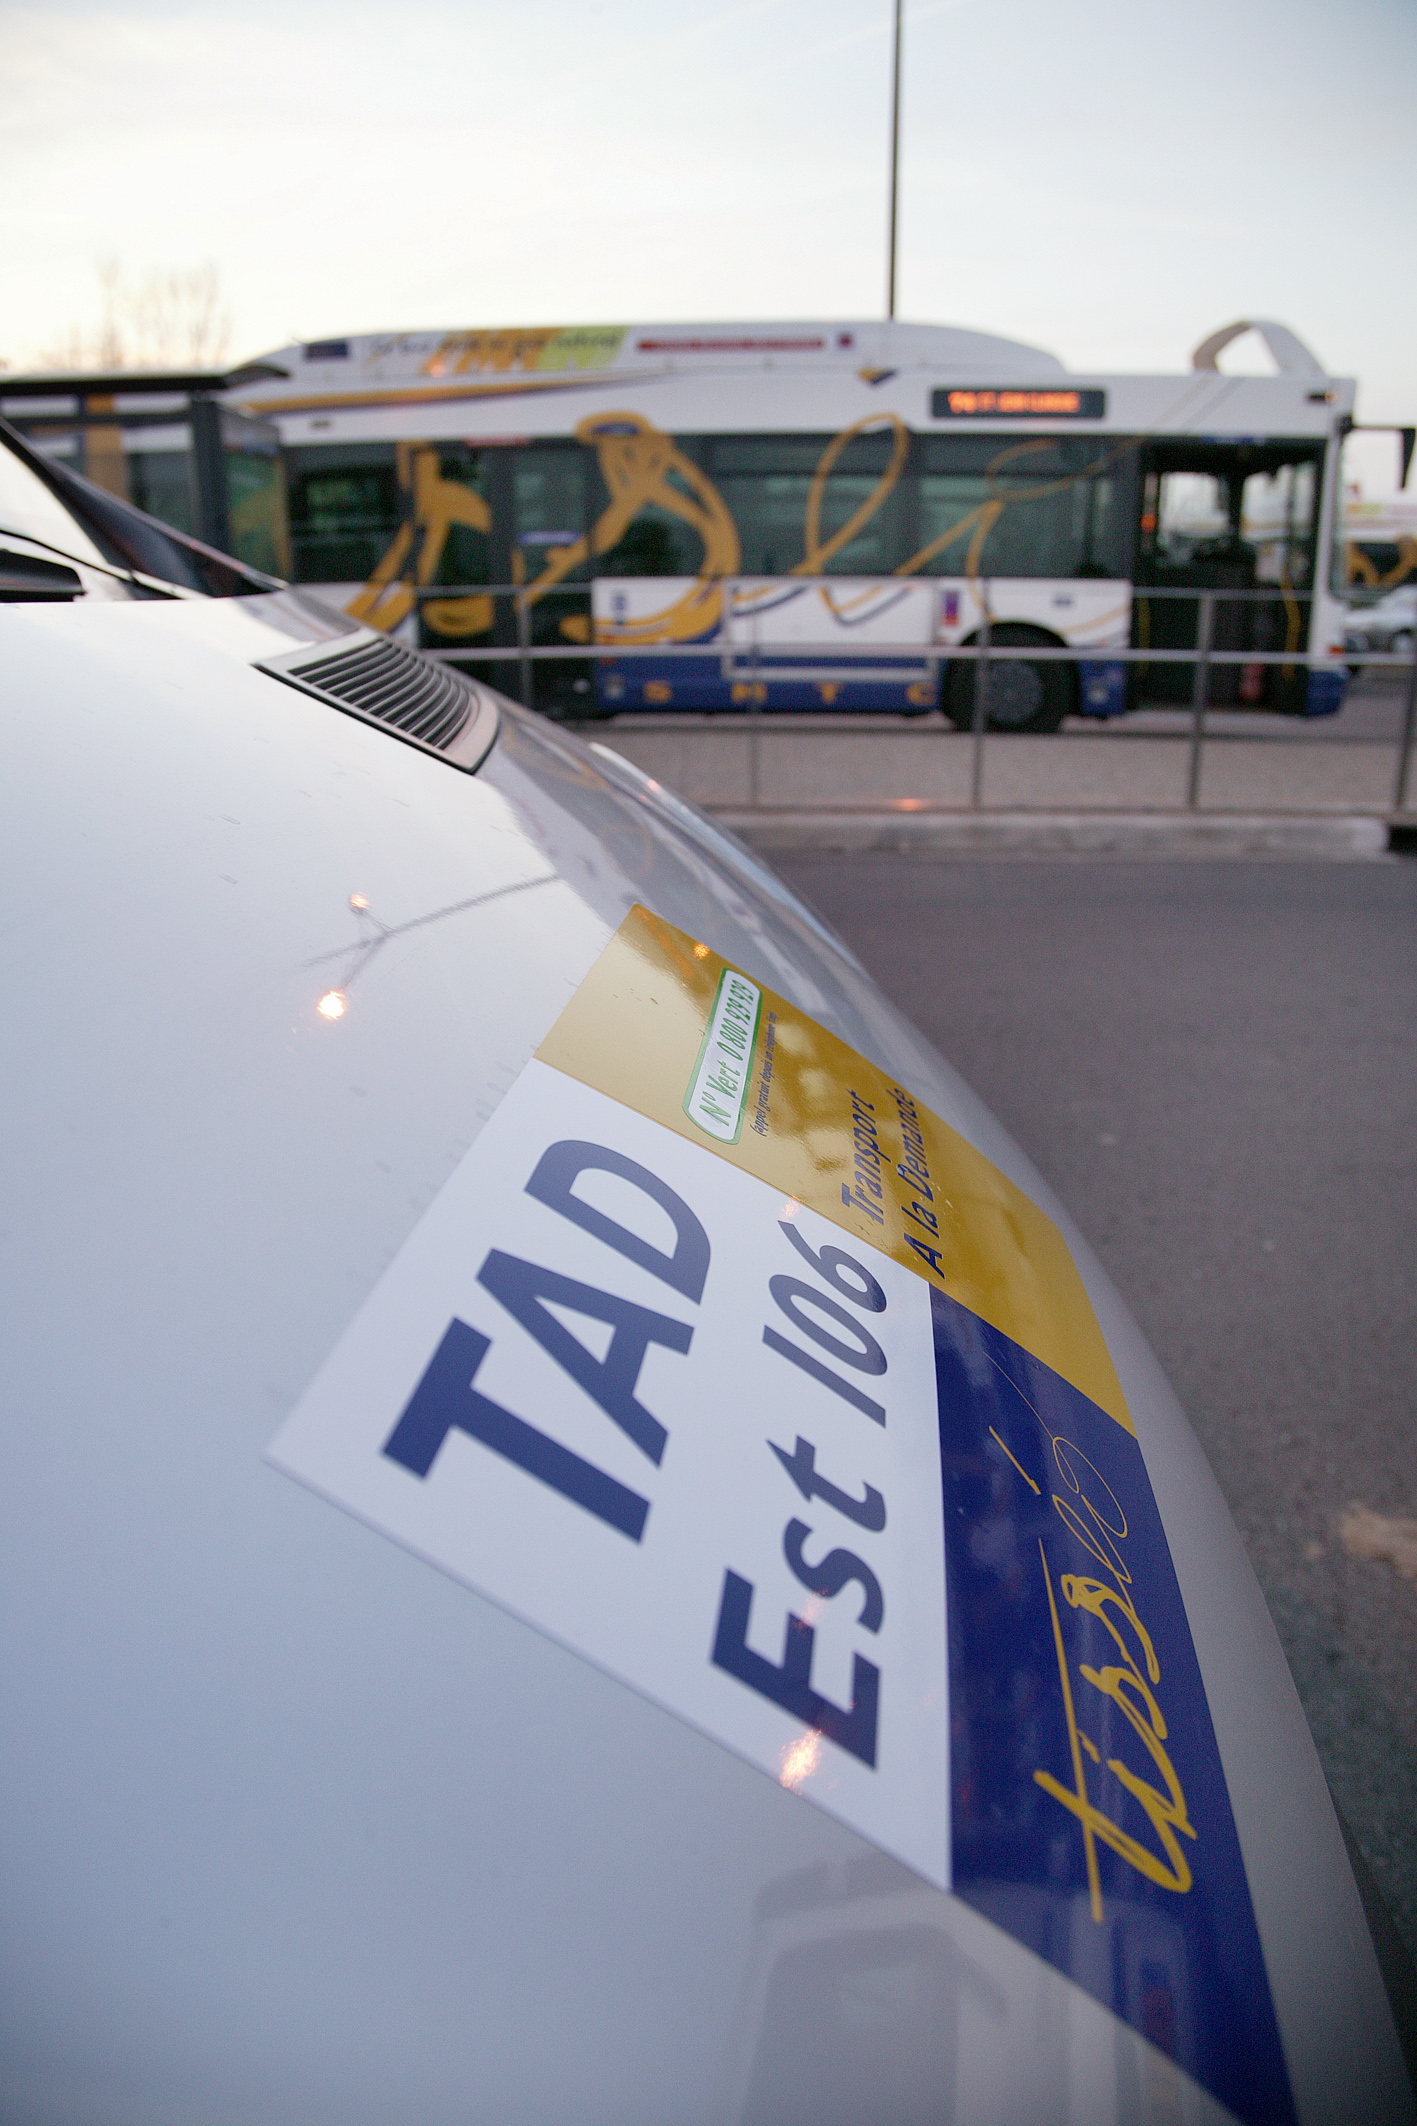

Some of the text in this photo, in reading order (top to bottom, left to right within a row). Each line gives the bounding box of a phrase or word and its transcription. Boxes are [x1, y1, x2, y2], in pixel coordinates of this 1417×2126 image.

[730, 979, 755, 1006] 929
[724, 996, 752, 1026] 929
[719, 1017, 749, 1050] 800
[716, 1041, 744, 1061] 0
[706, 1060, 741, 1099] Vert
[758, 1059, 775, 1083] depuis
[757, 1080, 771, 1112] gratuit
[750, 1104, 769, 1137] (appel
[841, 1087, 892, 1226] Transport
[886, 1087, 946, 1280] A la Demande
[379, 1138, 712, 1547] TAD
[709, 1219, 889, 1771] Est 106
